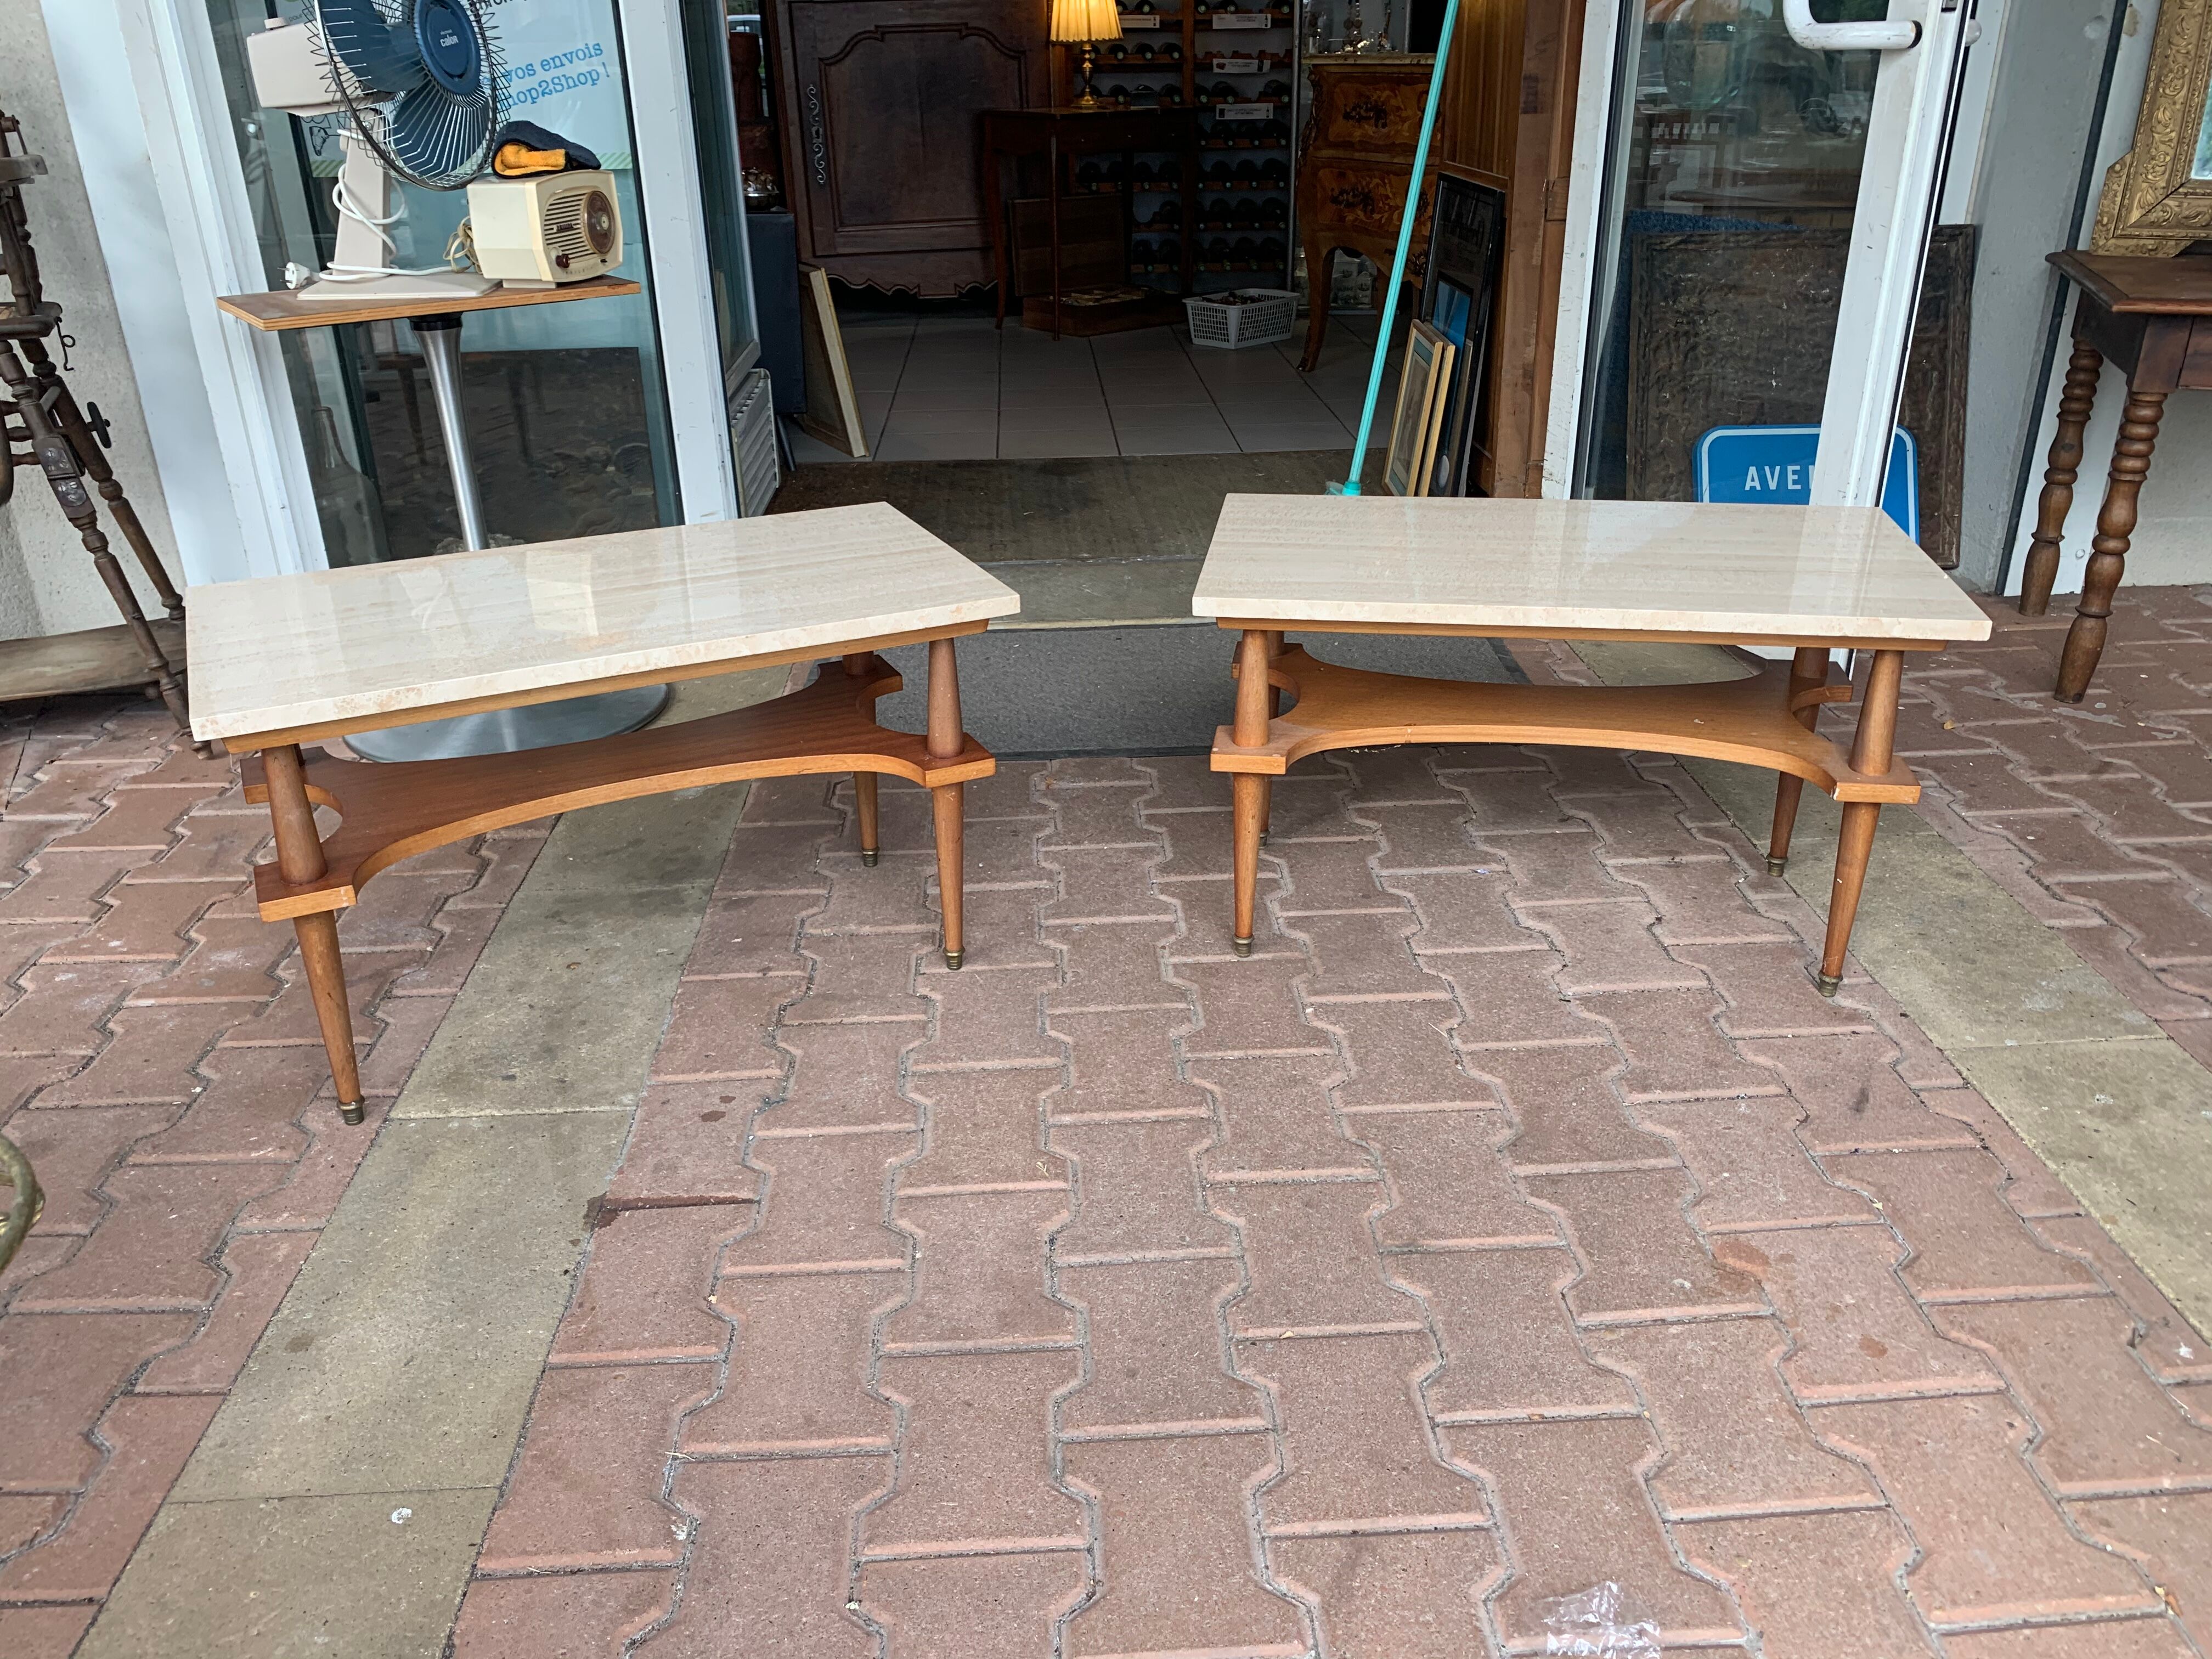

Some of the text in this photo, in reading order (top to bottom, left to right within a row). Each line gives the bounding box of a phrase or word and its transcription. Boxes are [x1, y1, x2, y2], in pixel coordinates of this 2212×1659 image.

[502, 43, 603, 83] vos envois
[1745, 465, 1815, 490] AVE
